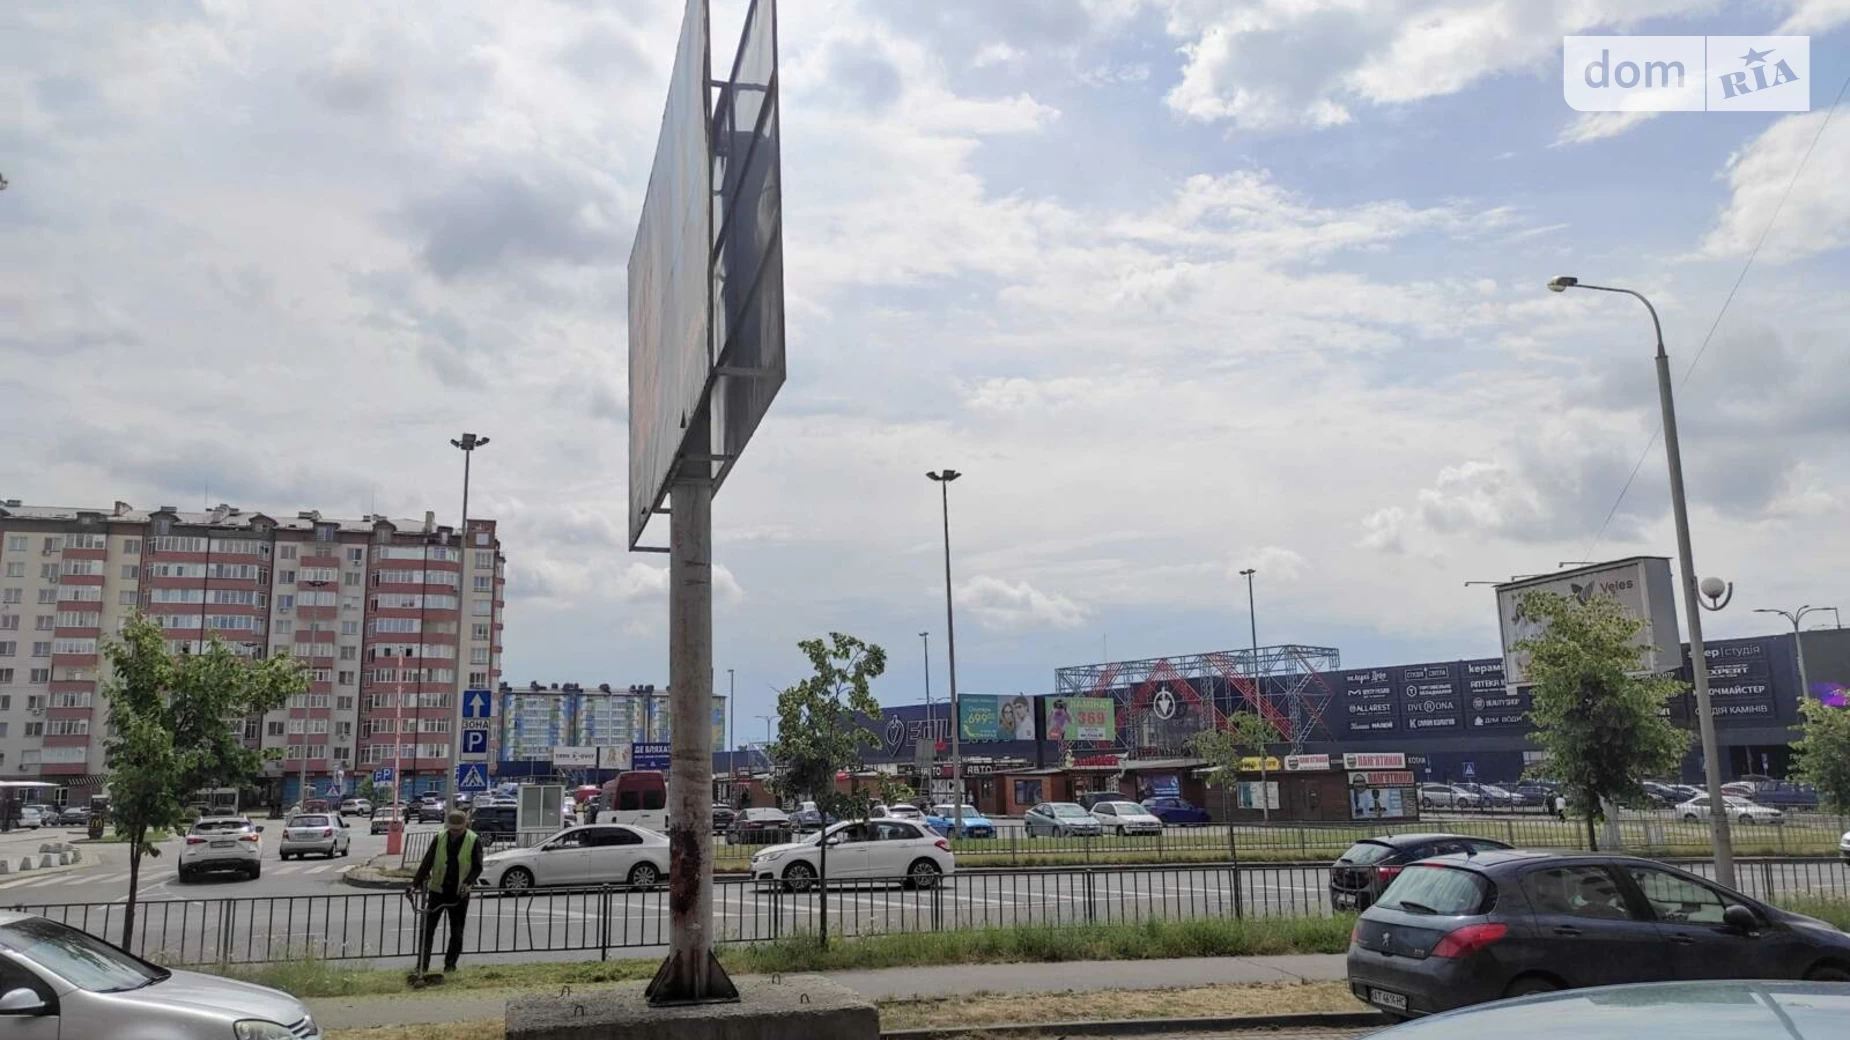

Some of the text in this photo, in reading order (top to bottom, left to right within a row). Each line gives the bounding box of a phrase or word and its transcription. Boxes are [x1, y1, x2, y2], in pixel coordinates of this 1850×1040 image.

[1601, 579, 1633, 594] Veles
[1729, 704, 1768, 715] КАМІНІВ
[463, 720, 489, 729] ЗОНА
[469, 732, 483, 752] P
